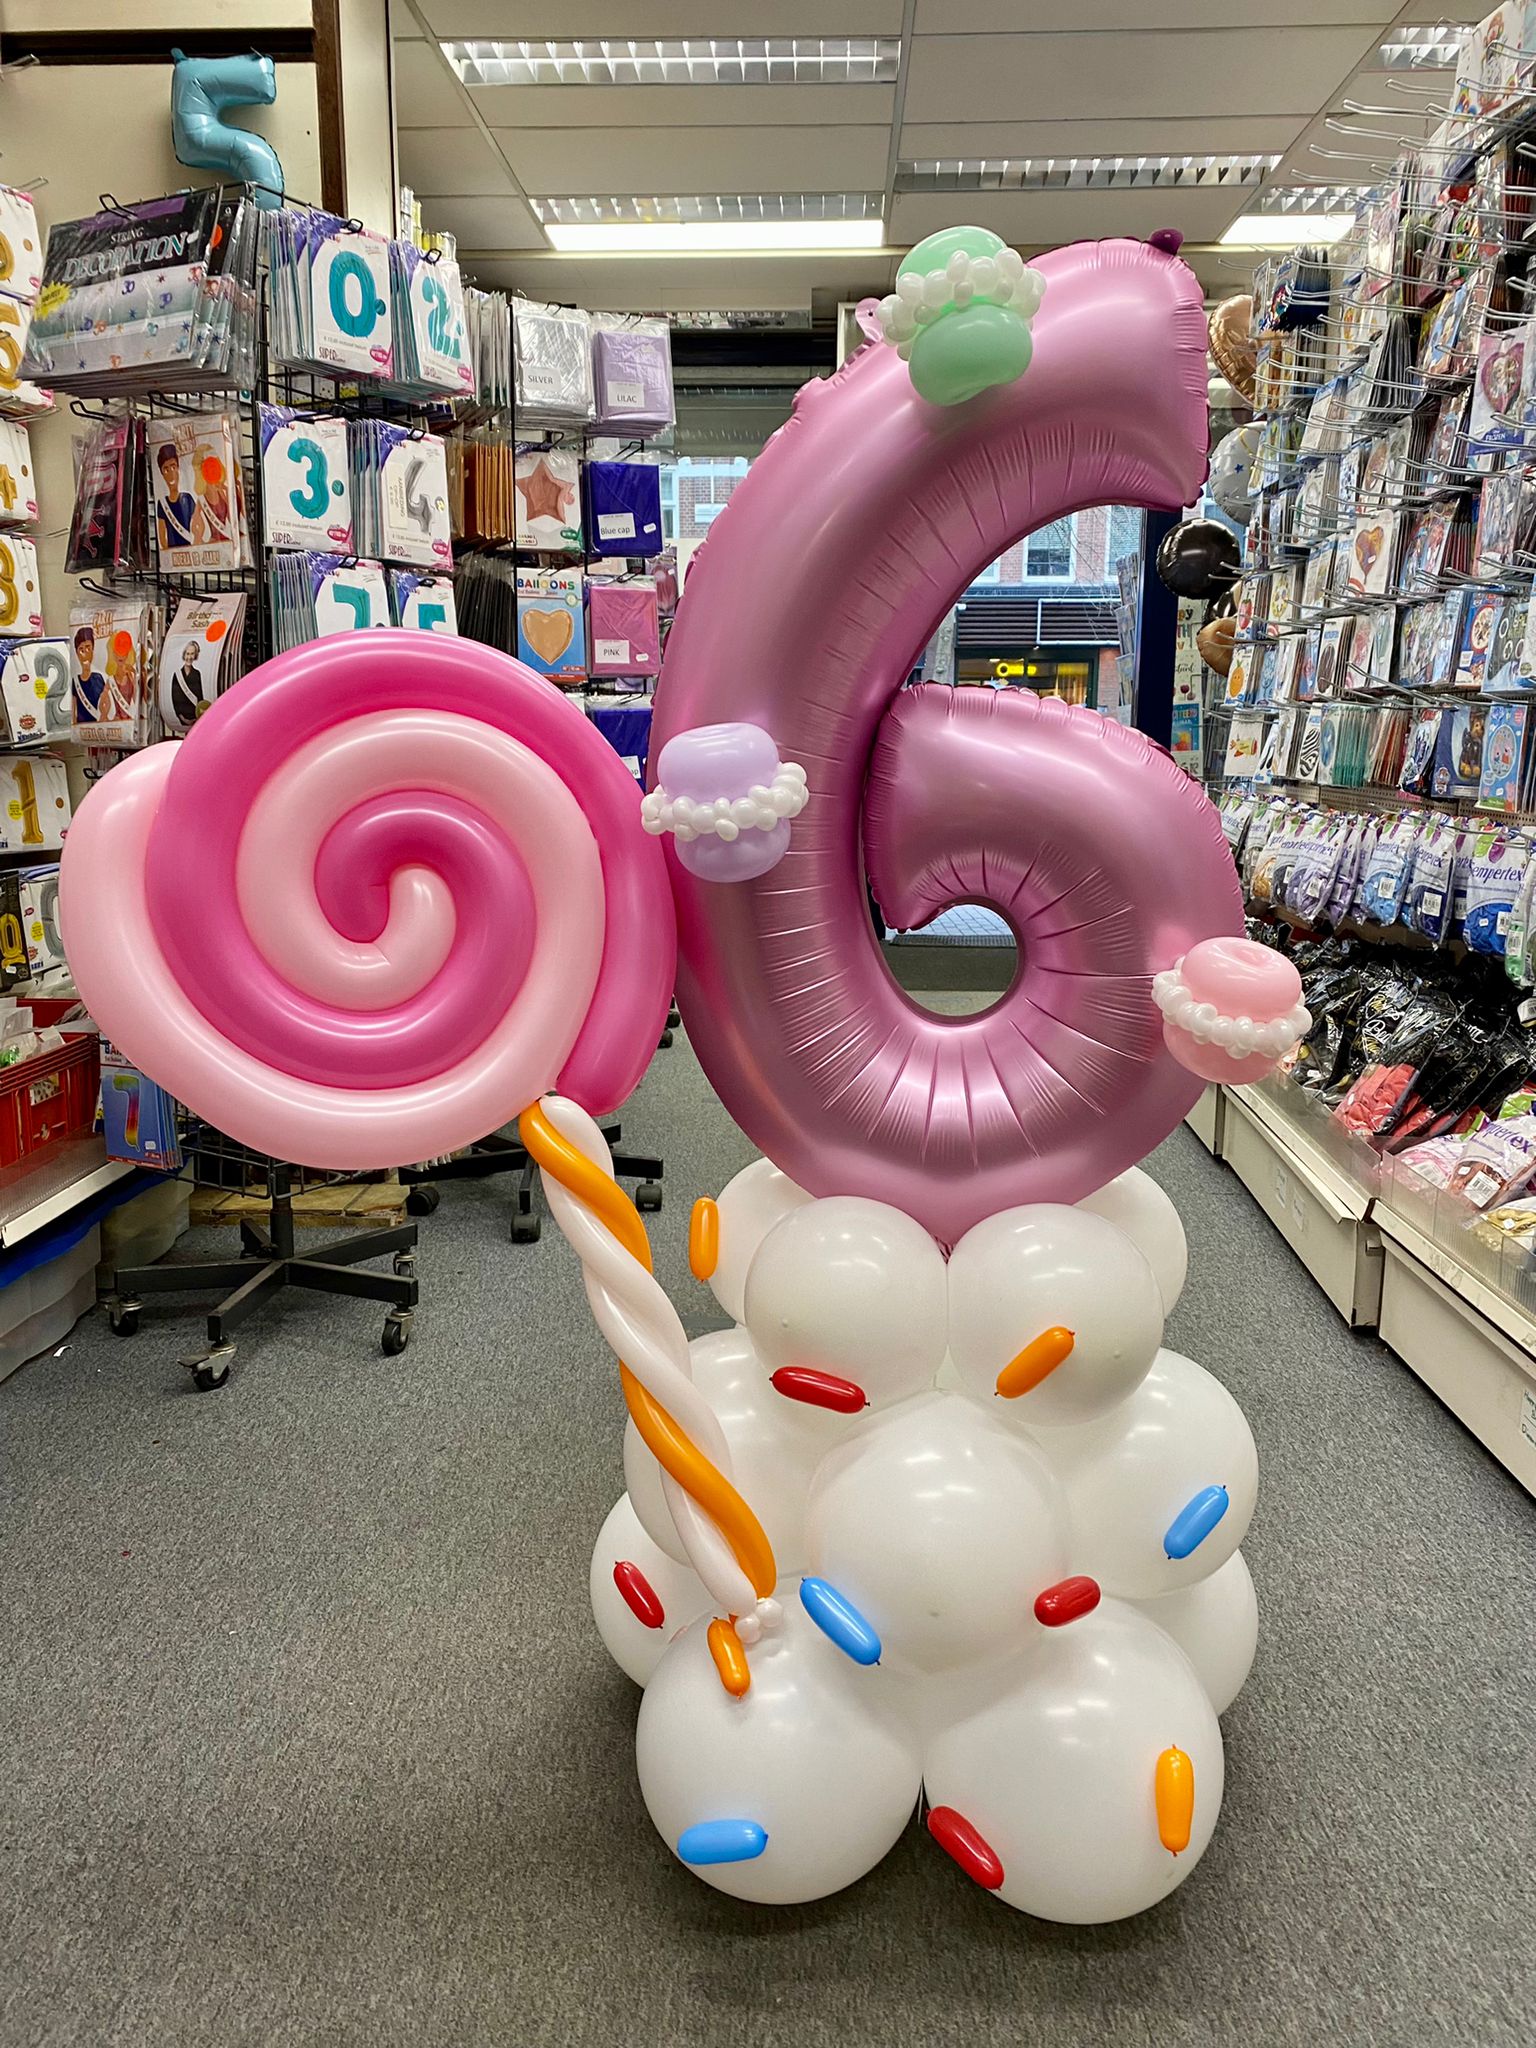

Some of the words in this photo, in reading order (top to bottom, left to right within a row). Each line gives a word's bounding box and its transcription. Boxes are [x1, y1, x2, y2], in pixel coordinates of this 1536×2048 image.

[110, 227, 145, 245] STRING
[62, 231, 188, 282] DECORATION
[329, 250, 377, 338] 0
[421, 276, 461, 360] 2
[527, 374, 553, 384] SILVER
[616, 394, 637, 403] LILAC
[287, 437, 330, 519] 3
[600, 526, 616, 535] Blue
[617, 527, 631, 535] cap
[603, 648, 620, 656] PINK
[1483, 1121, 1533, 1154] pertex
